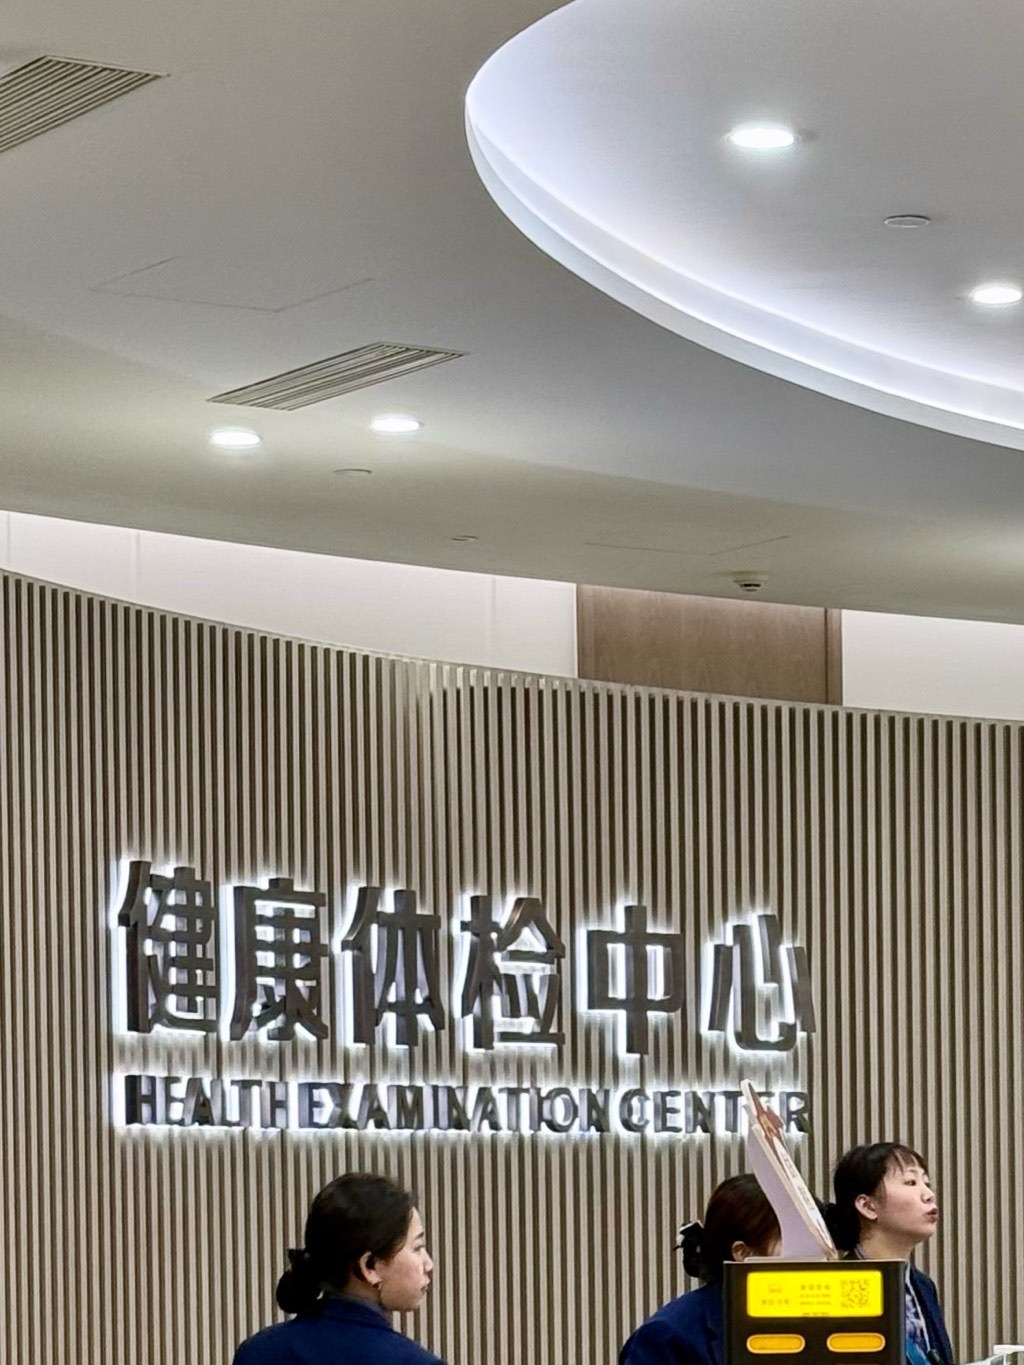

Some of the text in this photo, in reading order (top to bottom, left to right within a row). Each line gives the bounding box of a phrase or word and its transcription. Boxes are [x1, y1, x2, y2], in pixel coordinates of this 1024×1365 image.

[117, 859, 817, 1055] 健康体检中心
[123, 1073, 290, 1129] HEALTH
[298, 1081, 612, 1133] EXAMINATION
